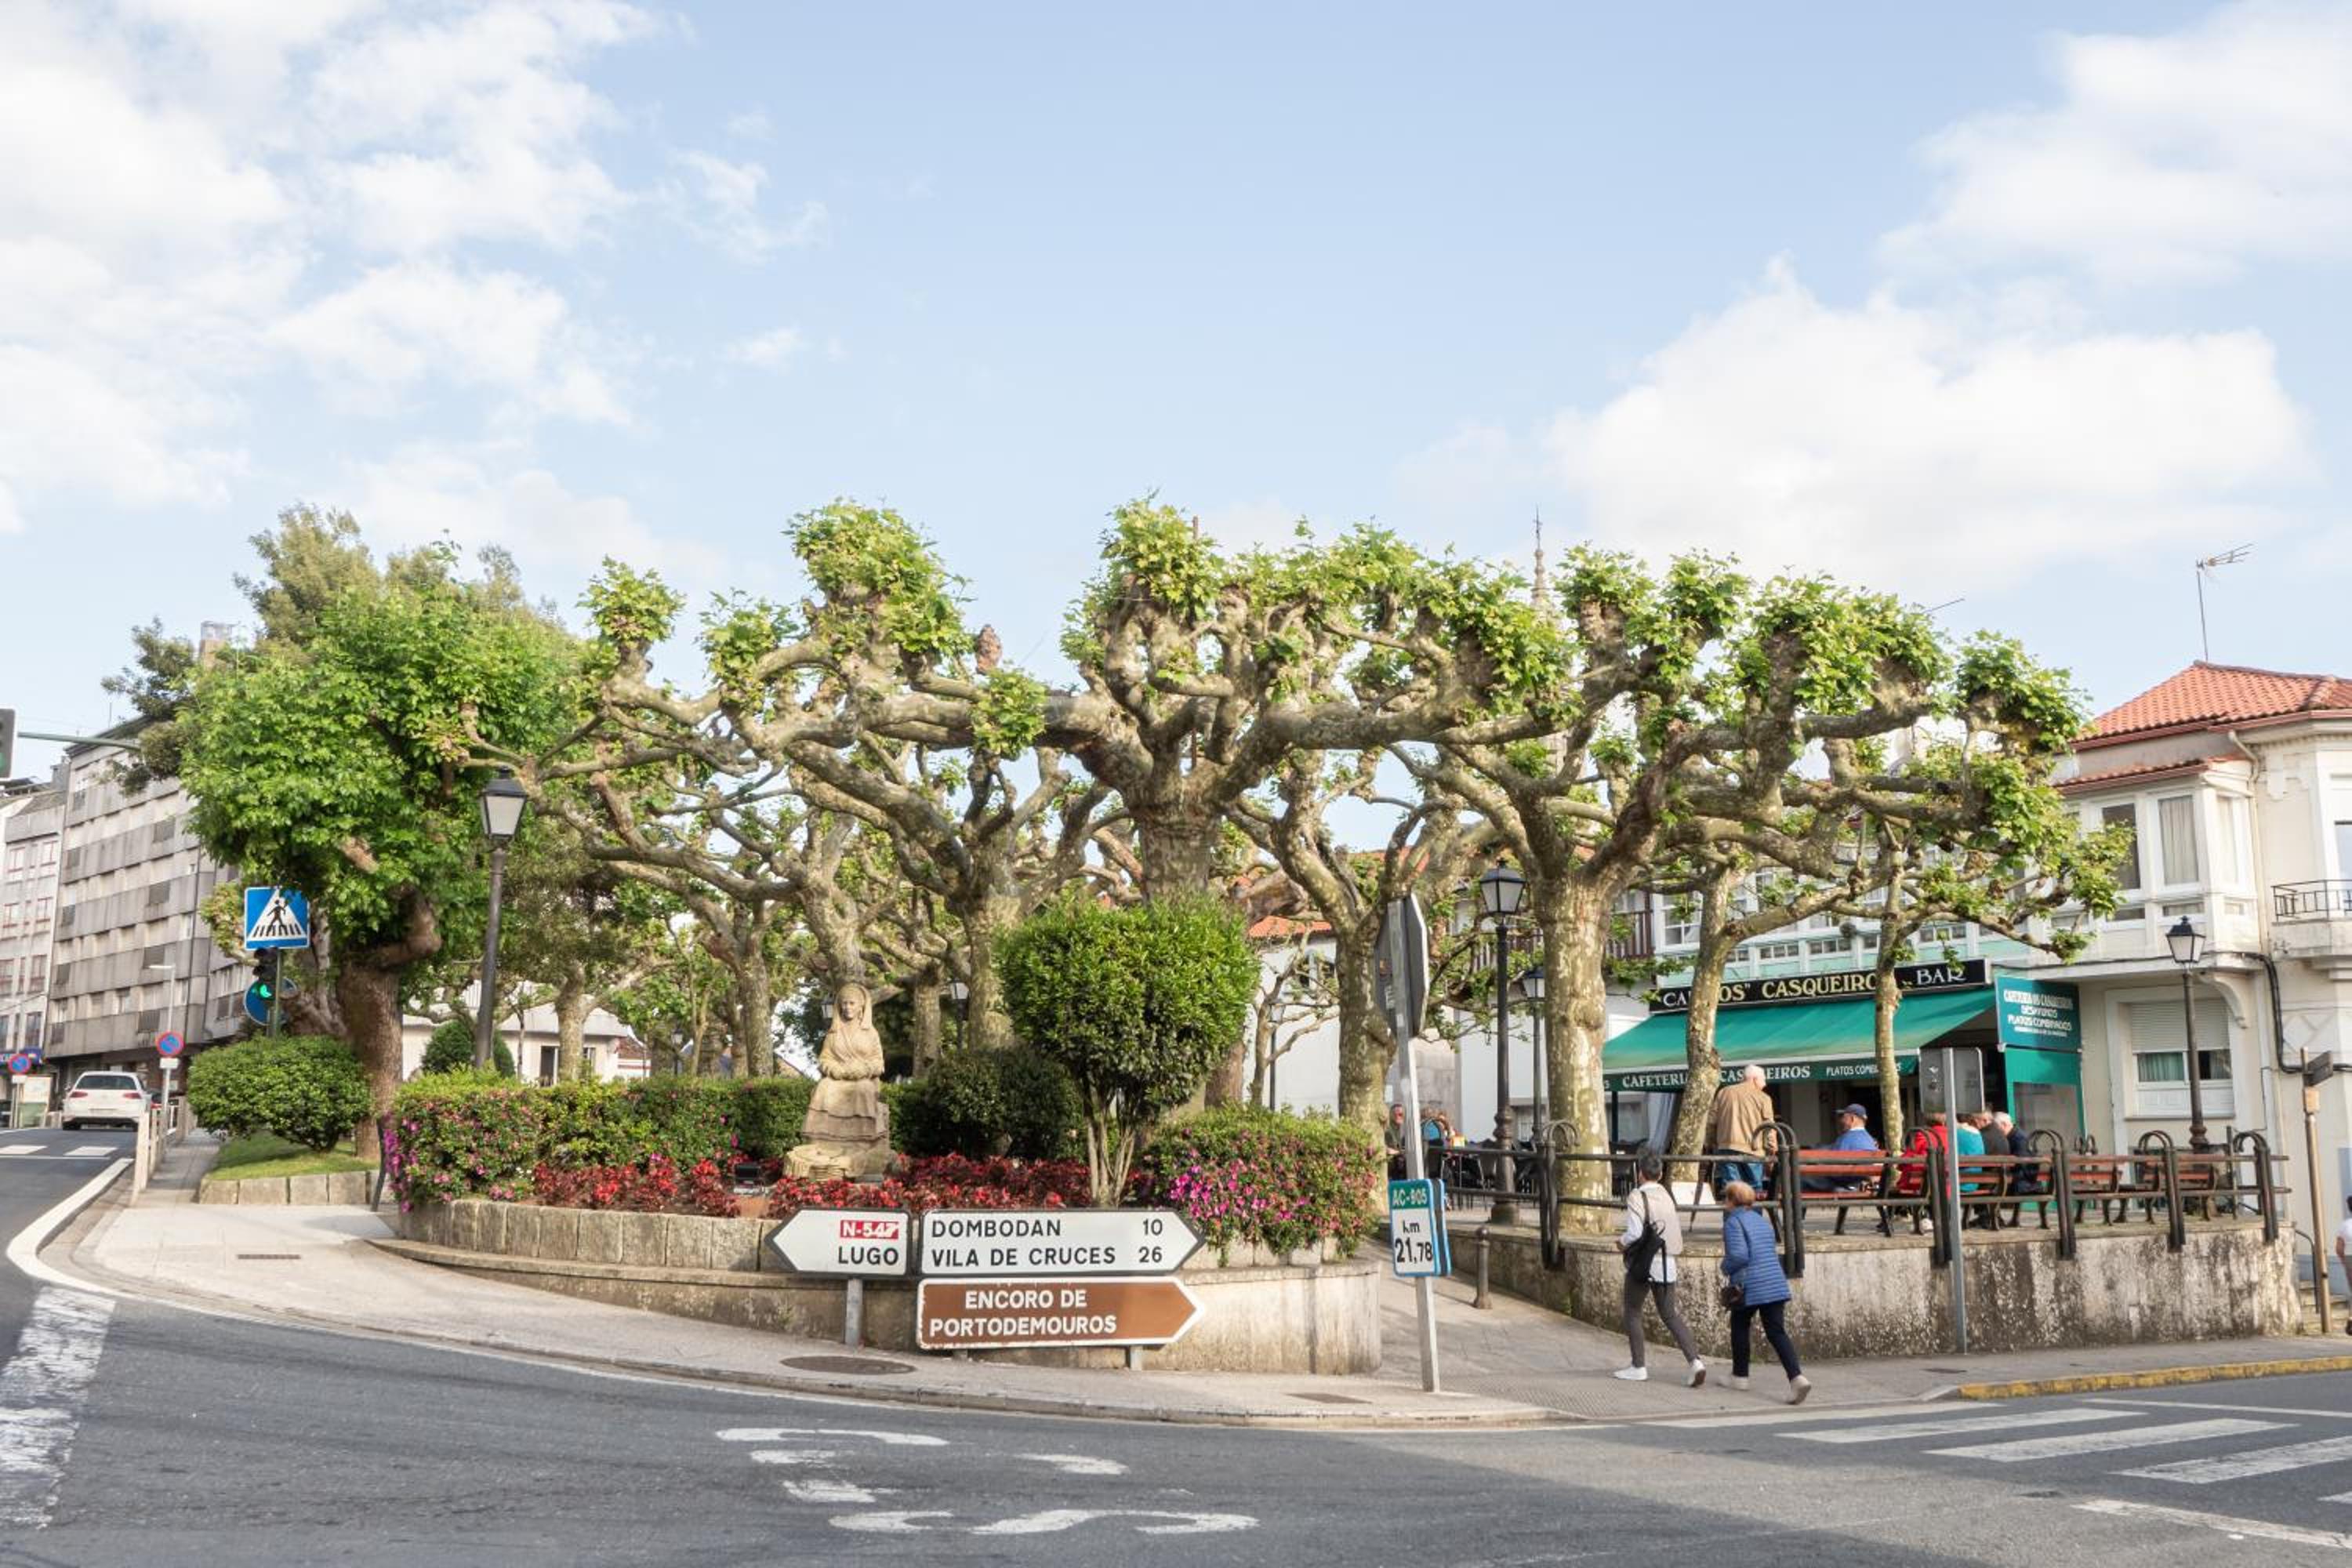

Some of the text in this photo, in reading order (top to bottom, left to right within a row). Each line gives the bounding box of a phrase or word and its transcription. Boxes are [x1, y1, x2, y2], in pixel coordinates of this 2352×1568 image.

[1762, 973, 1876, 999] CASQUEIRO
[1916, 966, 1967, 985] BAR
[1621, 1072, 1687, 1088] CAFETERI
[1719, 1065, 1811, 1083] CASEIROS
[1826, 1065, 1854, 1077] PLATOS
[842, 1221, 900, 1239] N-547
[931, 1218, 1163, 1238] DOMBODAN 10
[1403, 1220, 1421, 1233] km
[838, 1246, 899, 1265] LUGO
[931, 1247, 1163, 1267] VILA DE CRUCES 26
[965, 1289, 1087, 1309] ENCORO DE
[929, 1315, 1117, 1337] PORTODEMOUROS
